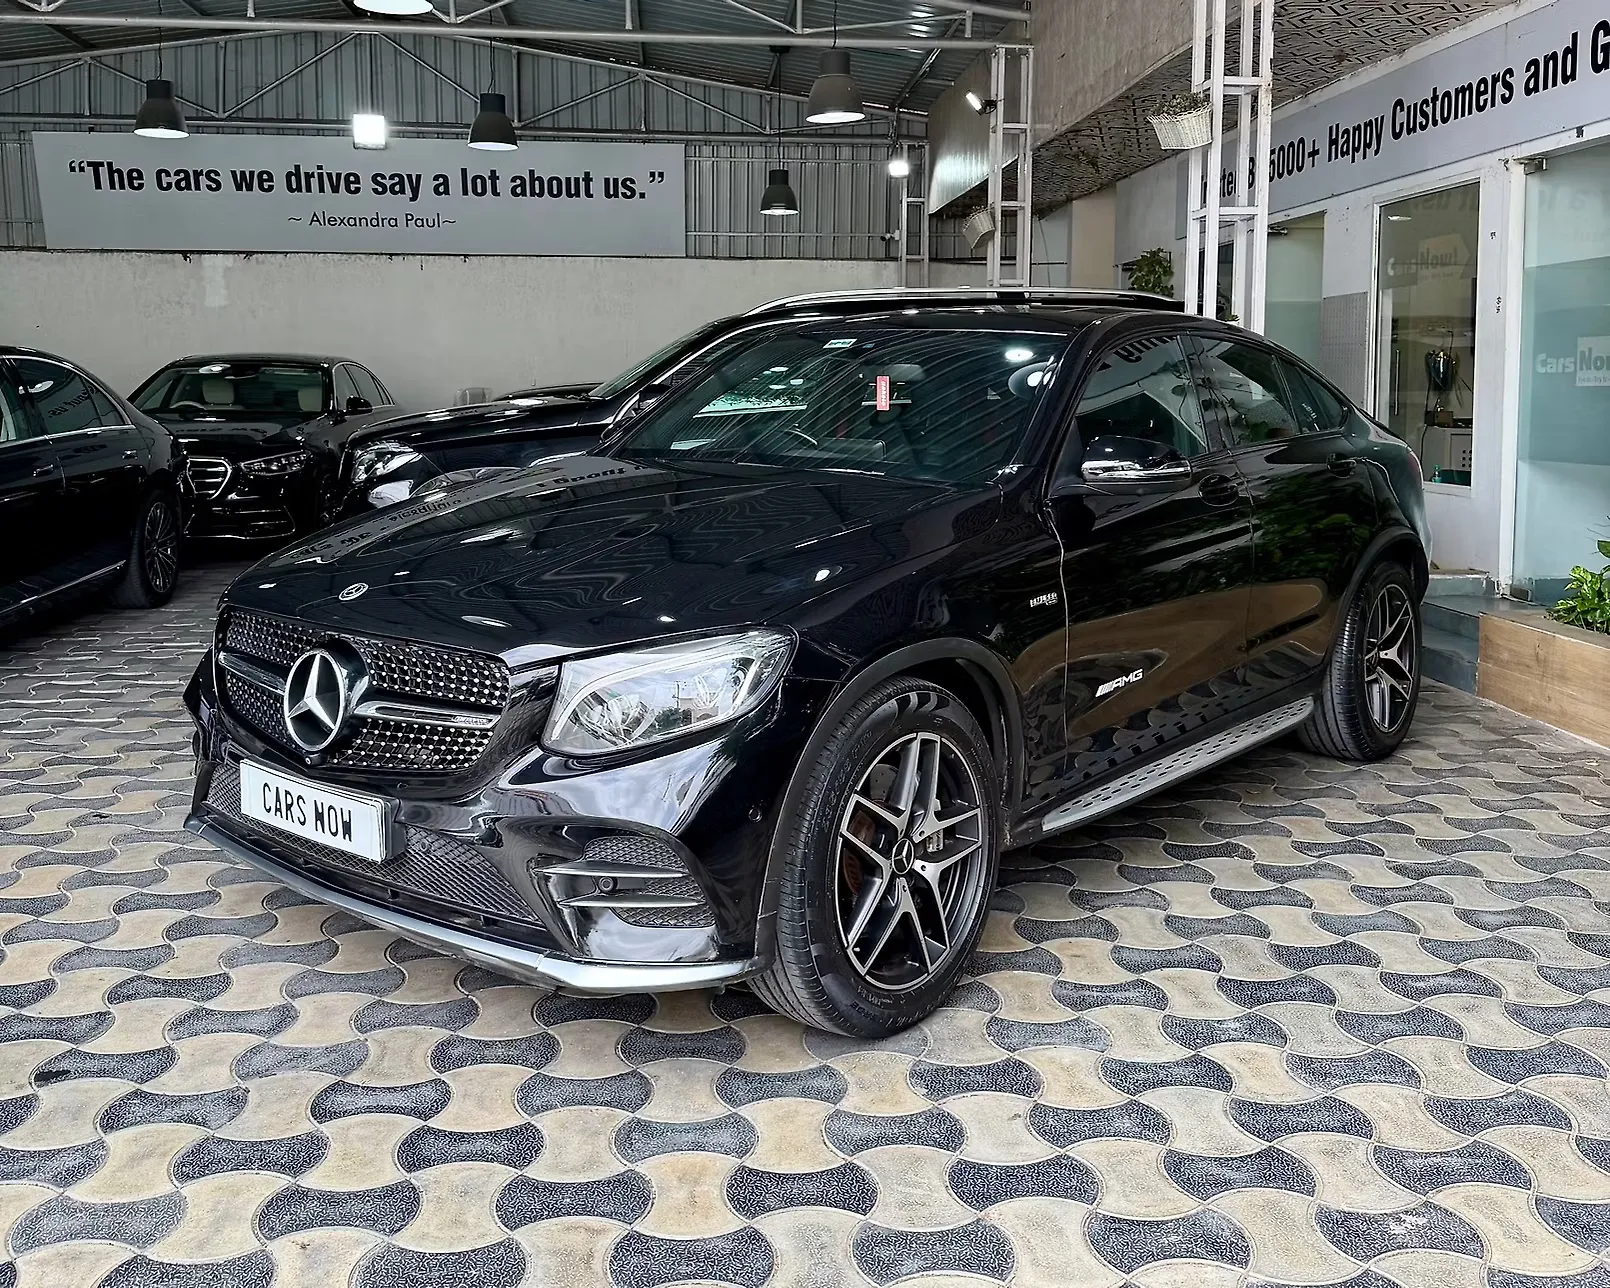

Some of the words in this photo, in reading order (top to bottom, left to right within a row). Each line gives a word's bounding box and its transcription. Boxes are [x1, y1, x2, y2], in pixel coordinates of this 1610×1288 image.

[1269, 136, 1320, 183] 5000+
[1328, 114, 1385, 163] Happy
[1391, 67, 1515, 140] Customers
[1524, 31, 1578, 96] and
[68, 160, 145, 192] “The
[155, 168, 223, 192] cars
[230, 168, 275, 193] we
[285, 164, 362, 195] drive
[371, 172, 422, 202] say
[432, 173, 450, 196] a
[460, 167, 500, 197] lot
[509, 169, 594, 198] about
[603, 171, 665, 199] us.”
[309, 211, 399, 228] Alexandra
[1536, 353, 1575, 373] Cars
[1579, 346, 1610, 371] No
[262, 782, 307, 826] CARS
[314, 799, 352, 843] NOW
